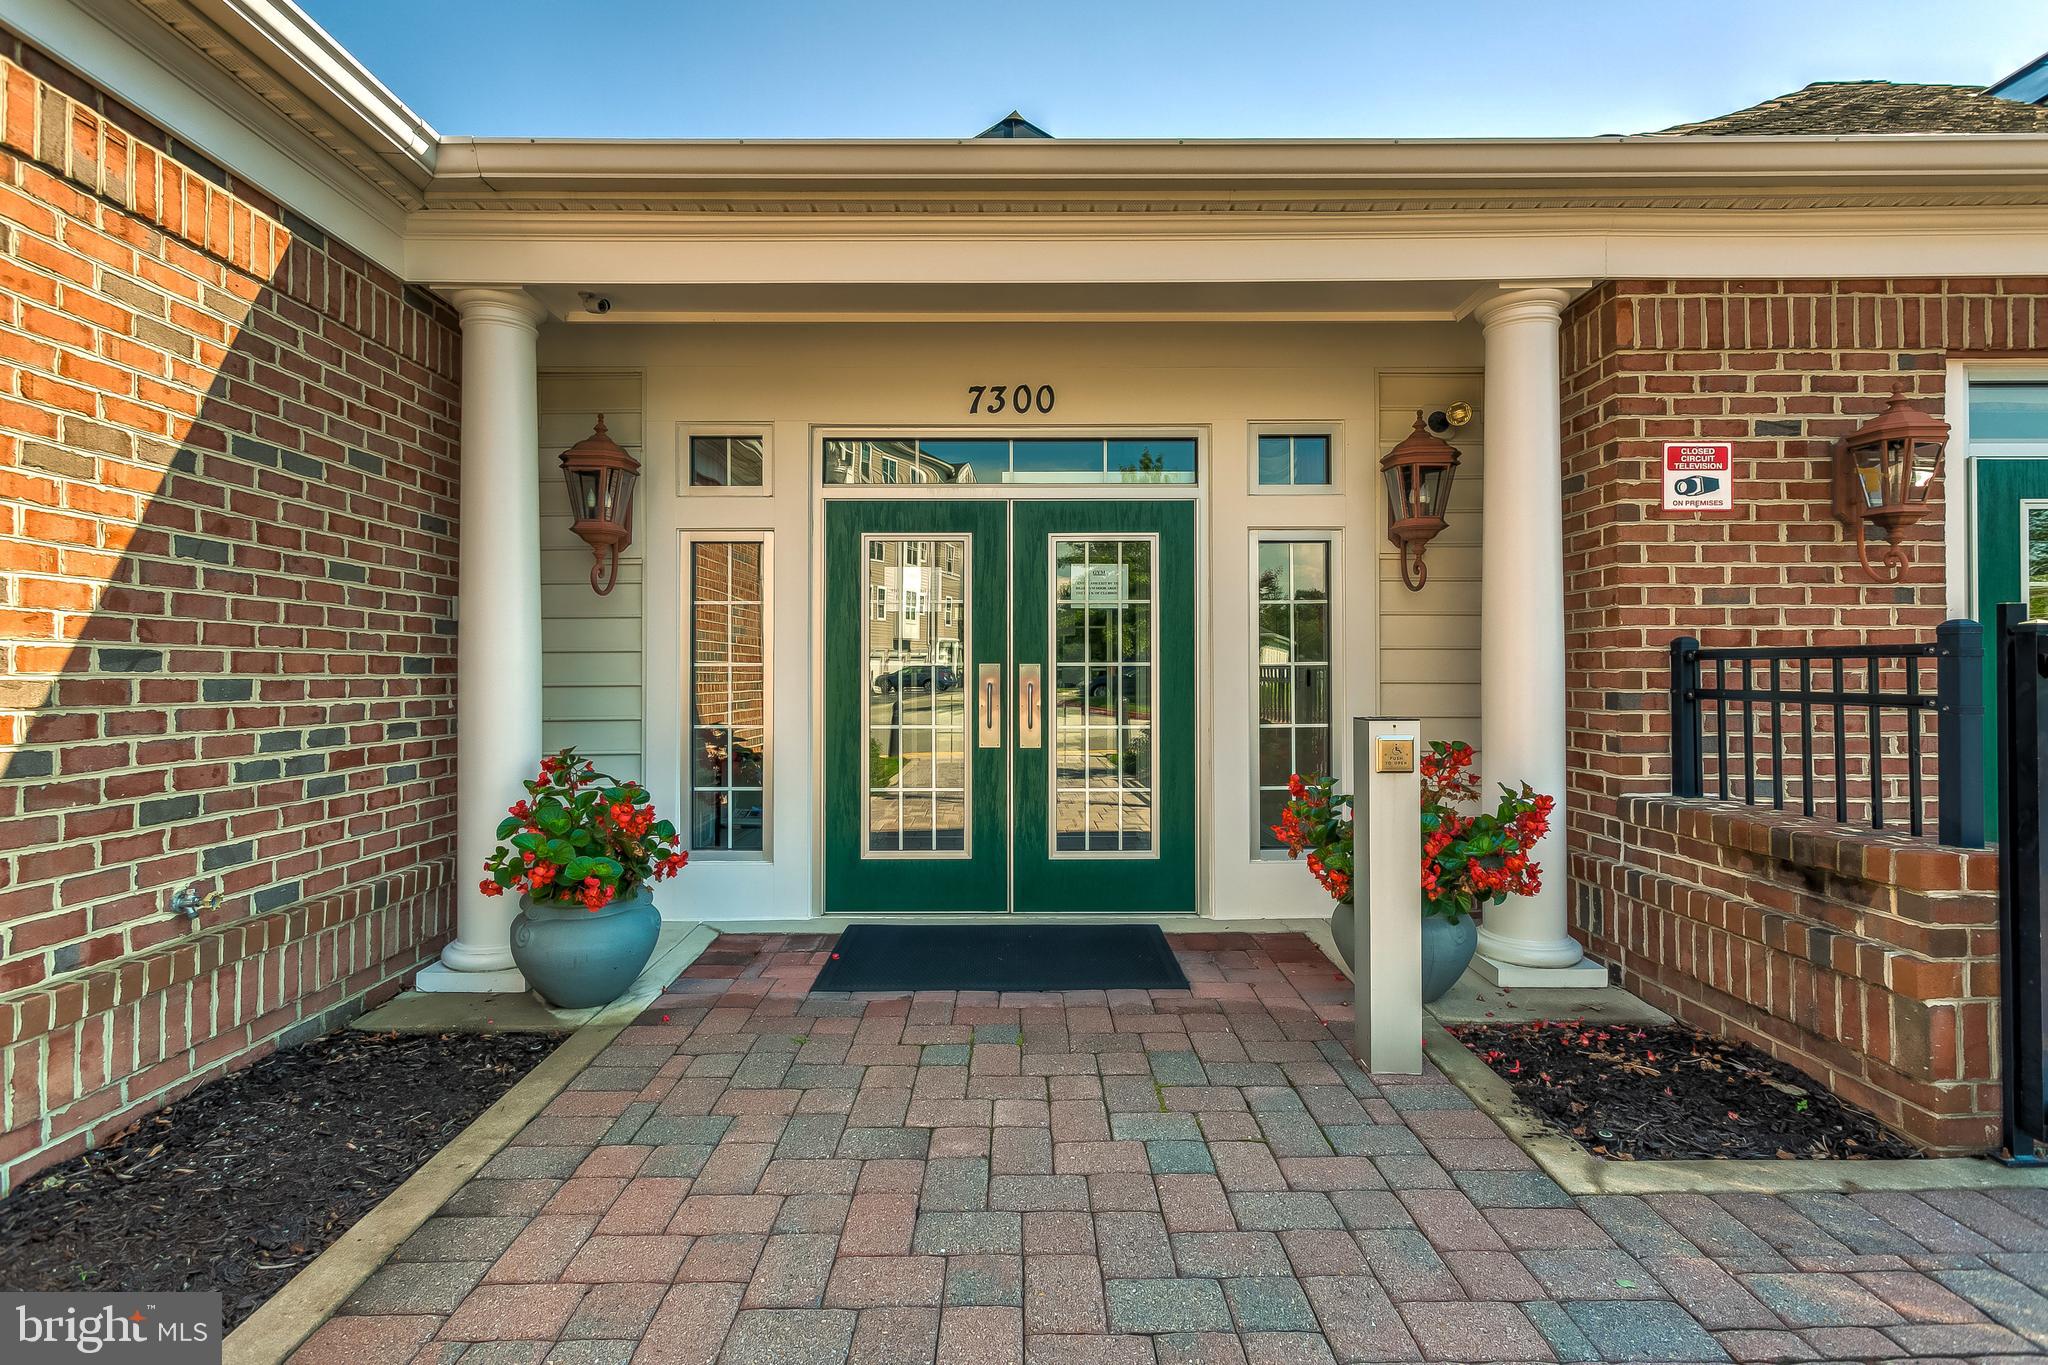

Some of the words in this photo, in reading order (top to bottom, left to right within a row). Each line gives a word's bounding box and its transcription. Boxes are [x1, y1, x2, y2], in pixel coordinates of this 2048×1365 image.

[968, 384, 1055, 414] 7300
[1680, 447, 1715, 455] CLOSED
[1674, 462, 1723, 470] TELEVISION
